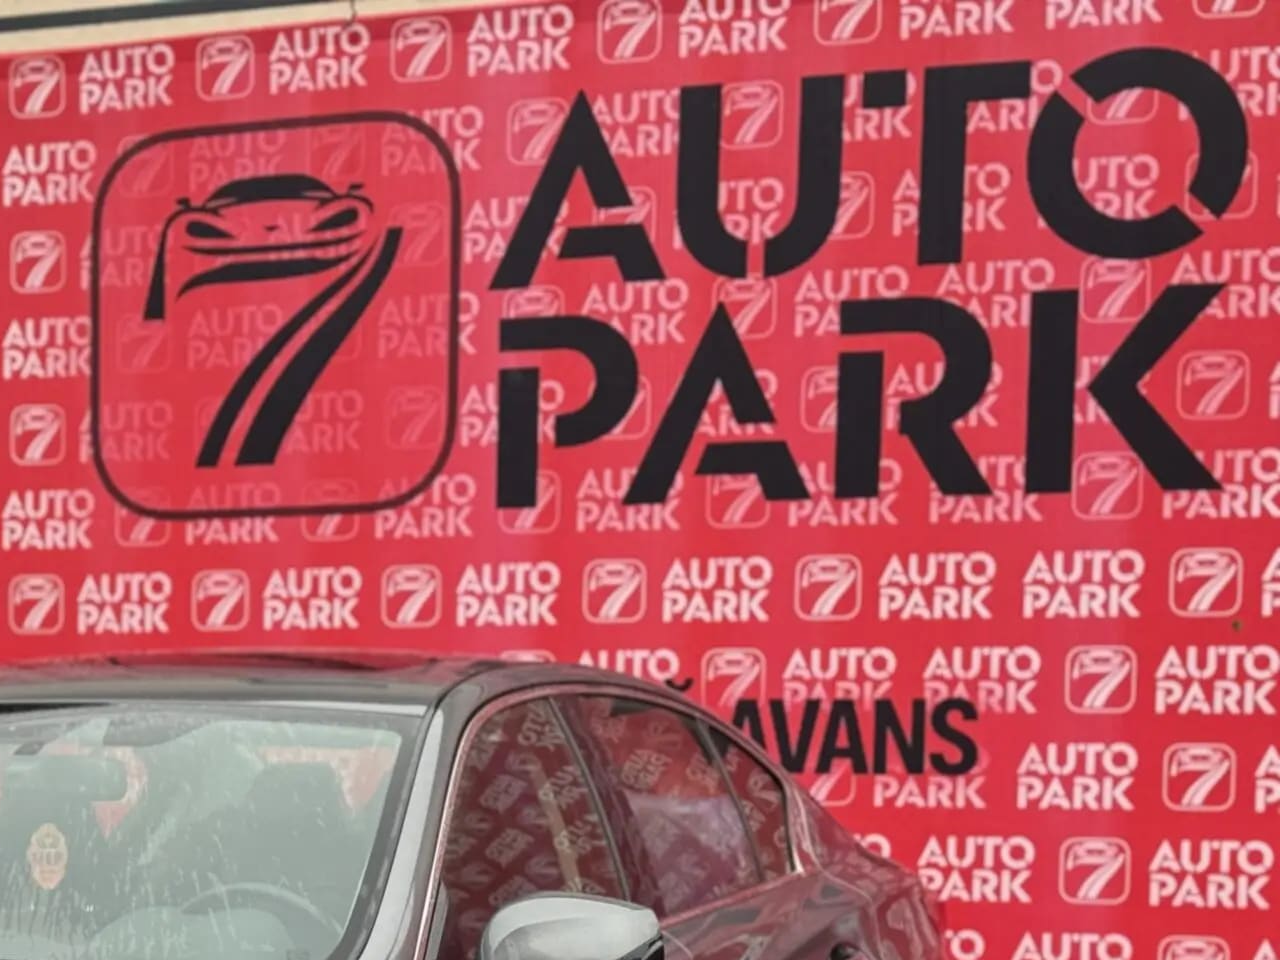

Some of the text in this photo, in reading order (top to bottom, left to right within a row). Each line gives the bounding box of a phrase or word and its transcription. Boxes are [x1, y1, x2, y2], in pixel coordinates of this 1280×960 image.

[466, 4, 573, 44] AUTO
[679, 17, 788, 58] PARK
[900, 0, 1015, 41] PARK
[269, 22, 369, 62] AUTO
[468, 37, 569, 76] PARK
[79, 44, 174, 83] AUTO
[270, 54, 366, 94] PARK
[80, 74, 171, 114] PARK
[3, 141, 96, 176] AUTO
[488, 46, 1249, 290] AUTO
[1072, 154, 1159, 190] UTO
[3, 172, 92, 207] PARK
[794, 265, 910, 301] AUTO
[936, 257, 1055, 295] AUTO
[581, 277, 689, 316] AUTO
[1204, 283, 1280, 320] ARK
[3, 317, 90, 349] AUTO
[188, 305, 282, 337] AUTO
[794, 304, 841, 338] PA
[3, 347, 90, 379] PARK
[496, 283, 1226, 508] PARK
[286, 420, 360, 455] ARK
[1210, 447, 1280, 485] UTO
[2, 490, 94, 520] AUTO
[576, 498, 682, 533] PARK
[788, 492, 898, 528] PARK
[929, 489, 1043, 524] PARK
[1162, 484, 1280, 520] PARK
[2, 519, 91, 550] PARK
[185, 514, 279, 546] PARK
[374, 505, 475, 540] PARK
[264, 566, 362, 599] AUTO
[457, 562, 560, 594] AUTO
[662, 556, 772, 590] AUTO
[879, 552, 996, 587] AUTO
[1024, 550, 1144, 585] AUTO
[77, 572, 171, 604] AUTO
[663, 588, 768, 622] PARK
[879, 585, 991, 620] PARK
[1023, 583, 1139, 618] PARK
[78, 602, 168, 634] PARK
[264, 596, 358, 630] PARK
[456, 594, 556, 626] PARK
[782, 647, 898, 681] AUTO
[923, 645, 1042, 681] AUTO
[1155, 645, 1280, 681] AUTO
[1154, 680, 1277, 715] PARK
[730, 697, 980, 777] AVANS
[1018, 743, 1138, 777] AUTO
[873, 776, 988, 809] PARK
[1017, 775, 1133, 810] PARK
[918, 836, 1035, 870] AUTO
[1149, 840, 1274, 876] AUTO
[919, 868, 1030, 902] PARK
[1149, 871, 1268, 909] PARK
